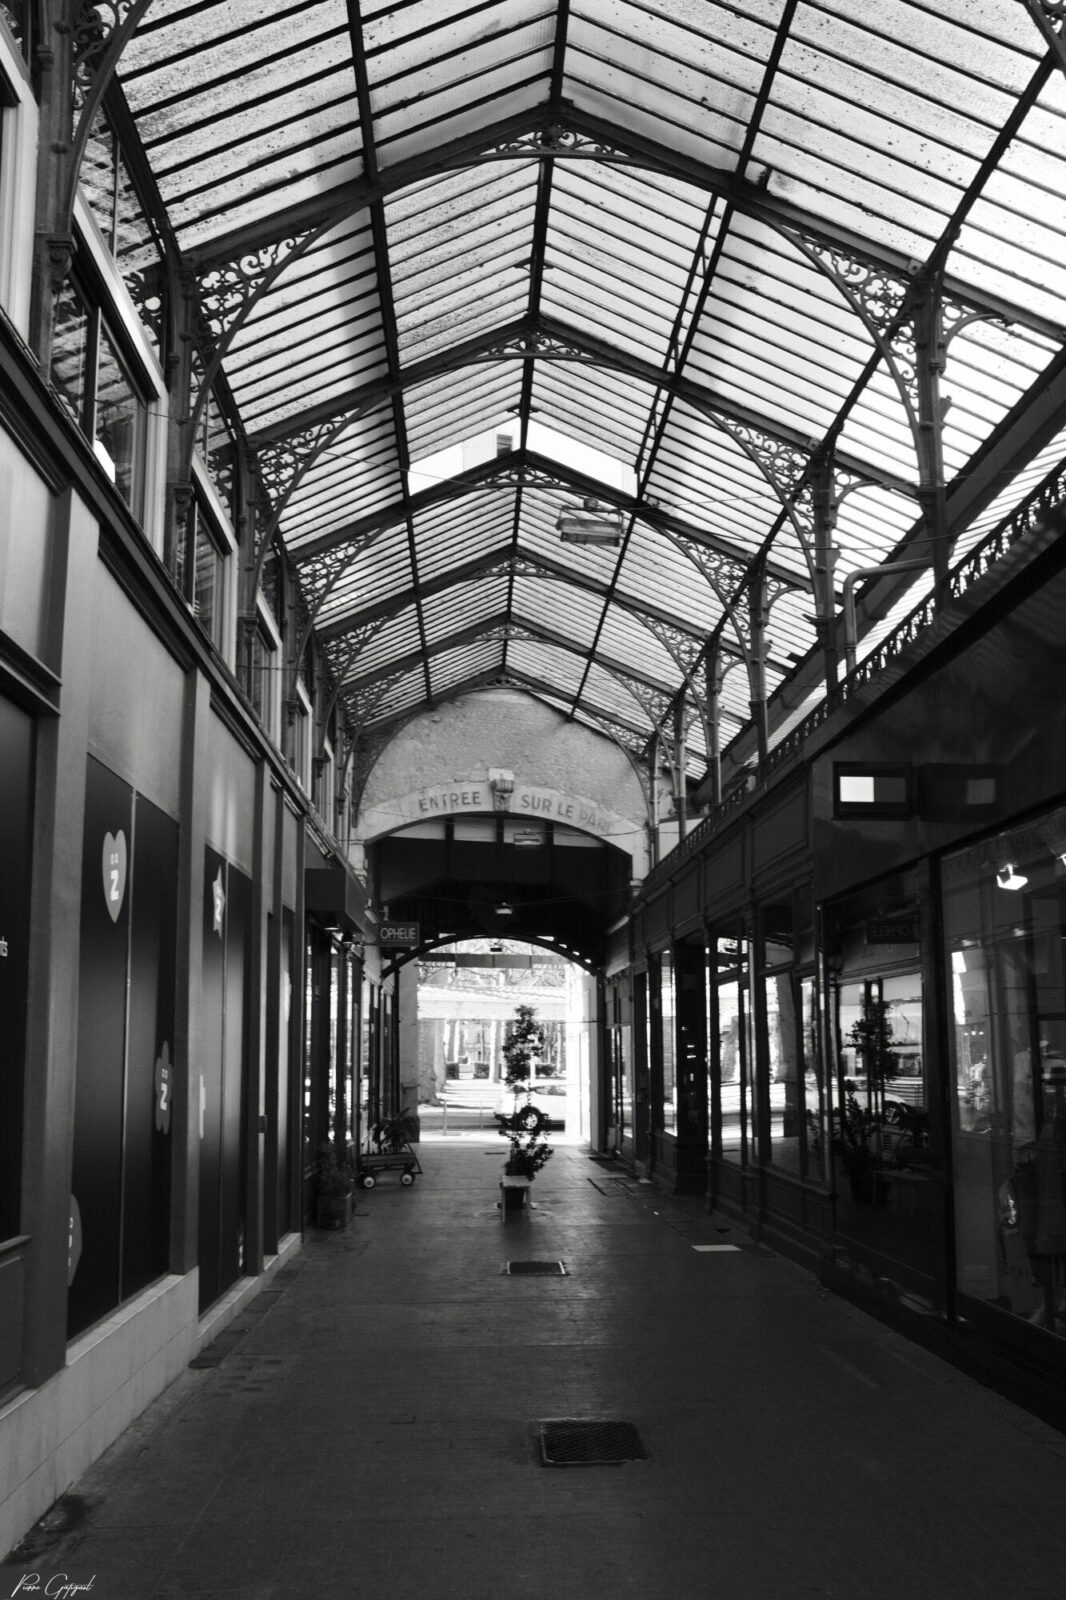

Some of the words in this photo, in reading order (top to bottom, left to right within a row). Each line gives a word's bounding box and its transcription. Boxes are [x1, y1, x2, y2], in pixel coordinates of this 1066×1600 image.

[418, 791, 482, 812] ENTREE
[522, 793, 553, 811] SUR
[556, 802, 575, 819] LE
